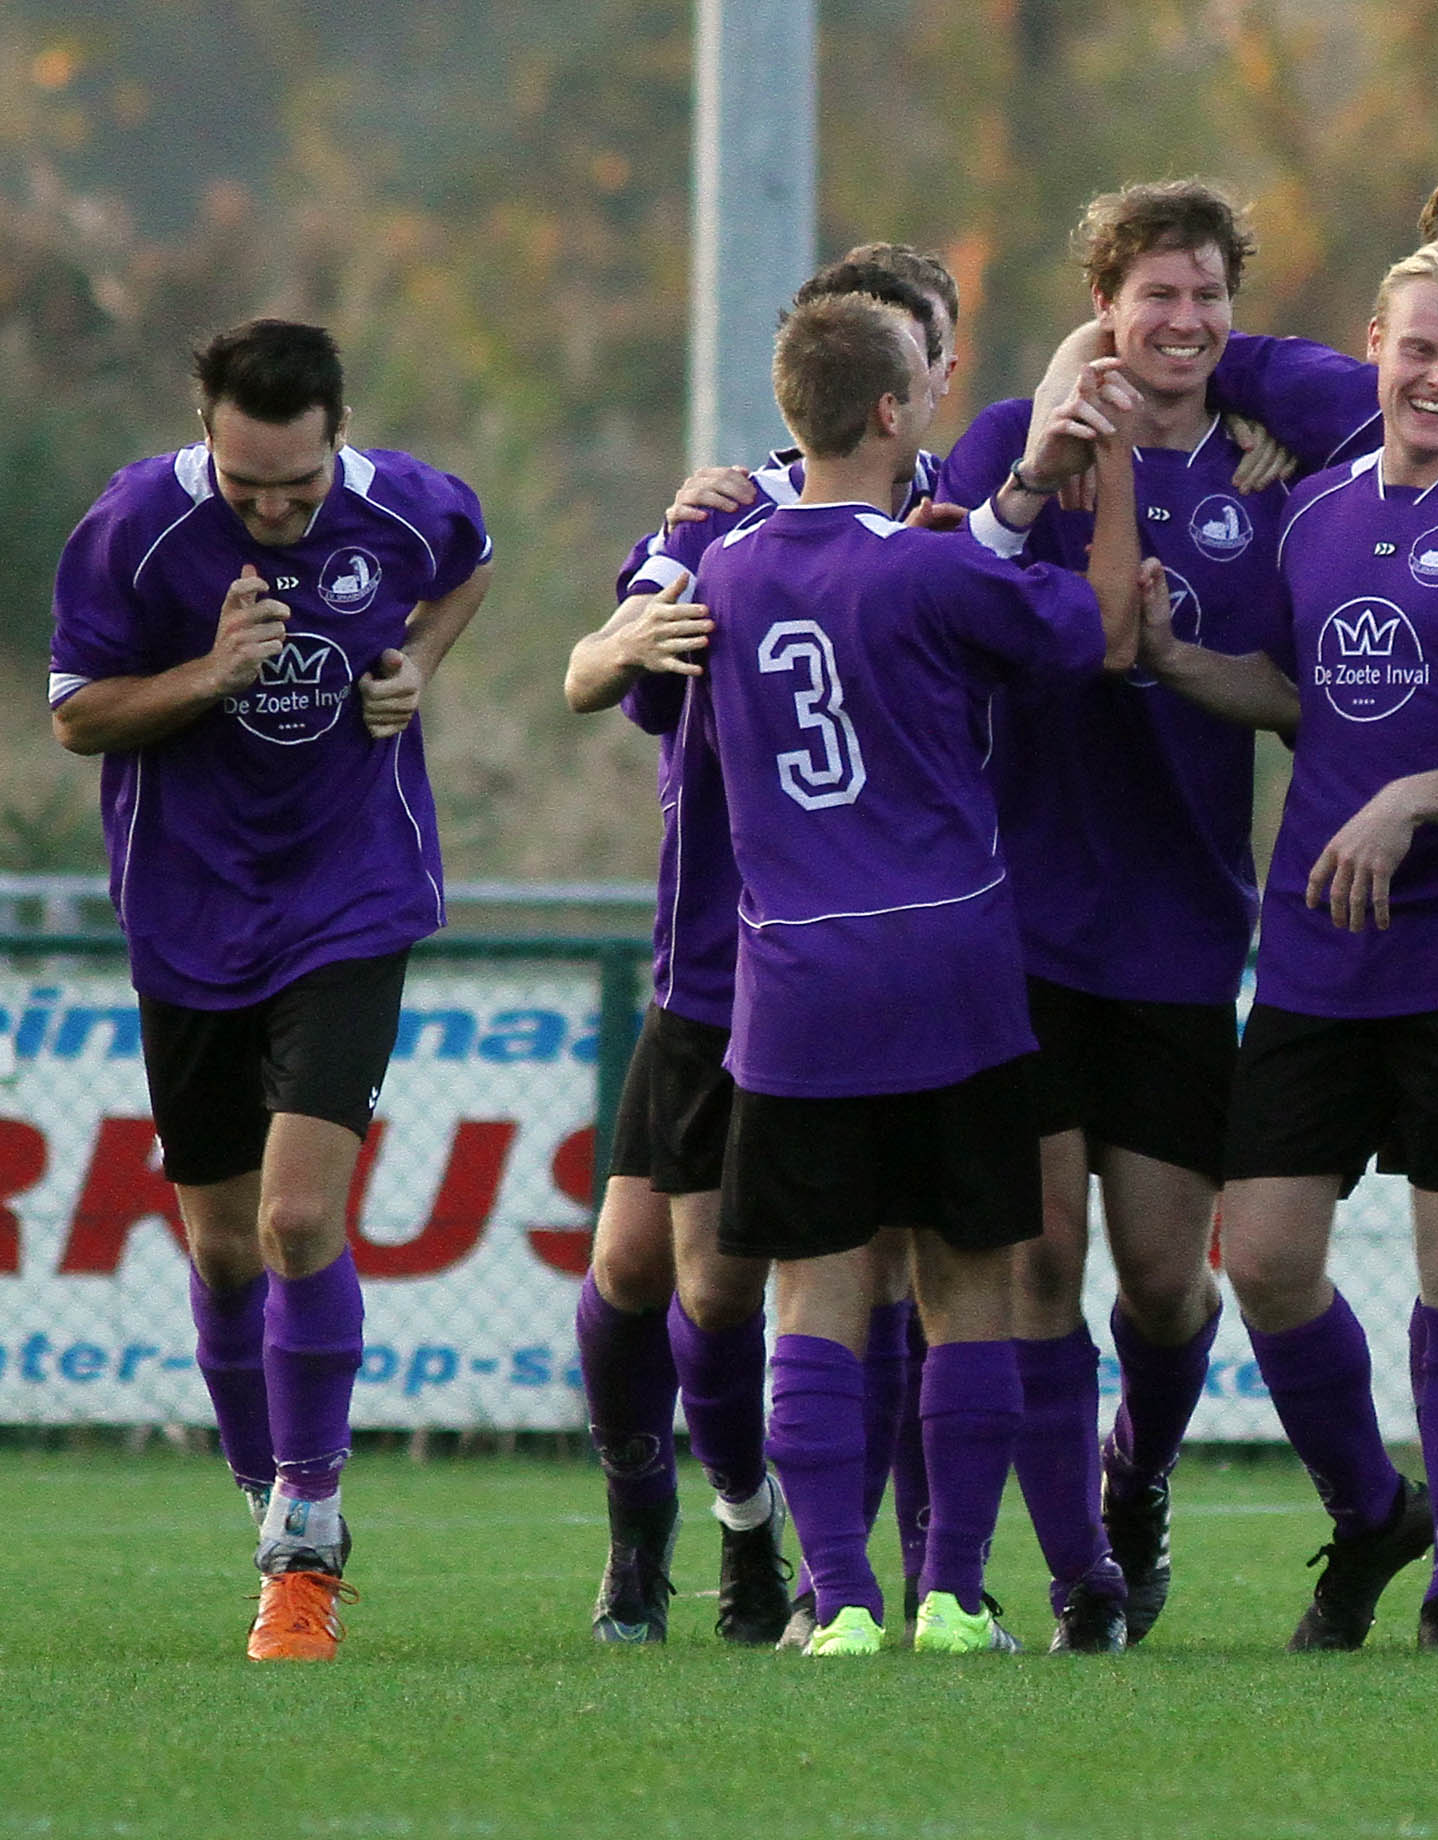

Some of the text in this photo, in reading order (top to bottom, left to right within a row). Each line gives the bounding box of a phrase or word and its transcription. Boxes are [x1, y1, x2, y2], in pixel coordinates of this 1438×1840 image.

[1314, 663, 1430, 685] De Zoete Inval
[223, 696, 250, 714] De
[255, 691, 309, 714] Zoete
[758, 620, 867, 811] 3
